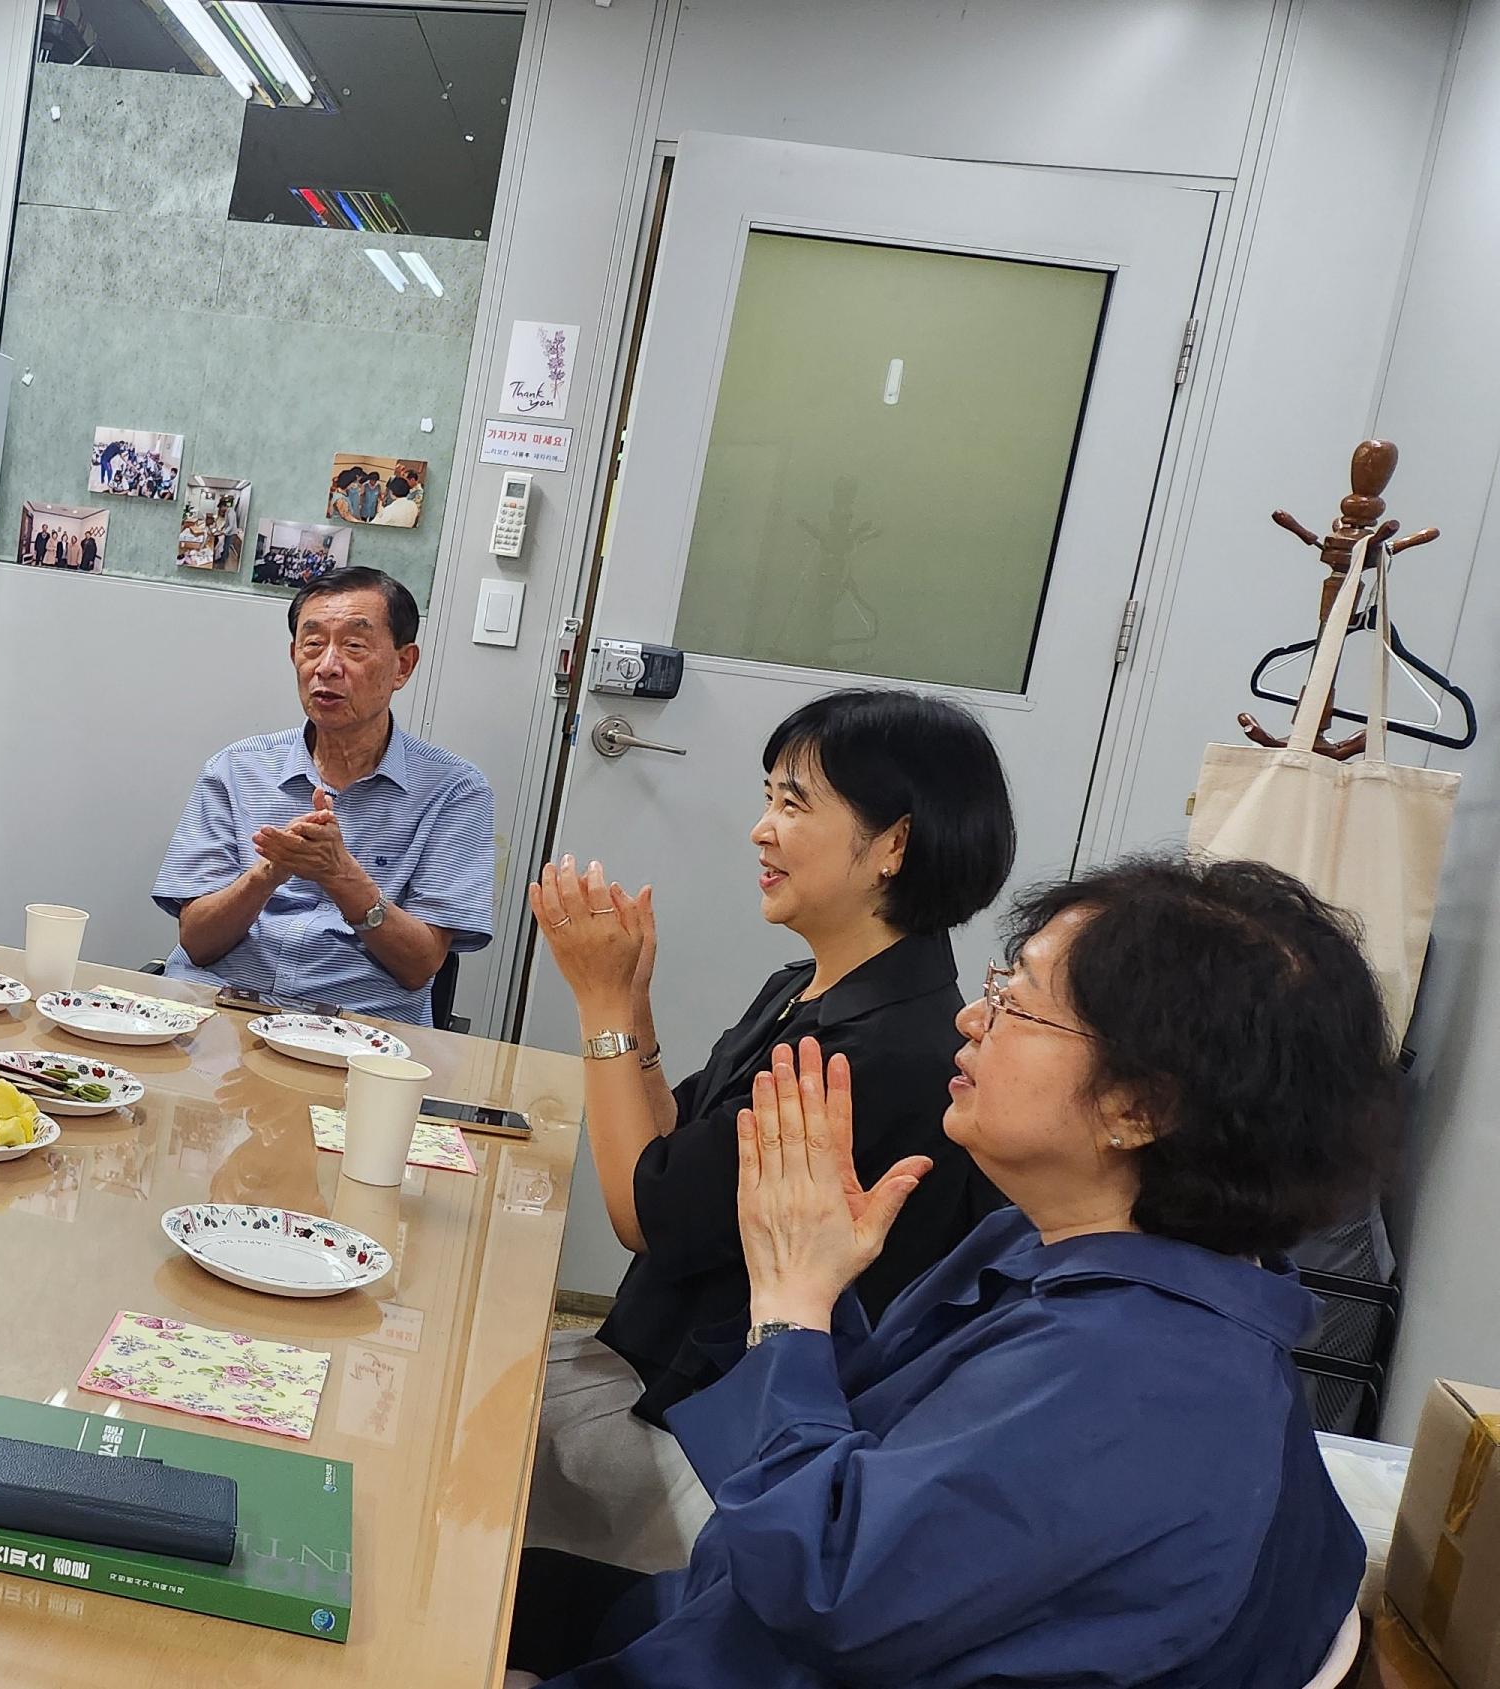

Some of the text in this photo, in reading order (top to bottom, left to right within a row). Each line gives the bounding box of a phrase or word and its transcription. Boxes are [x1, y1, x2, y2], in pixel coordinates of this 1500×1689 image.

[509, 380, 546, 399] Thank
[516, 399, 554, 412] you
[52, 1557, 91, 1580] 총론
